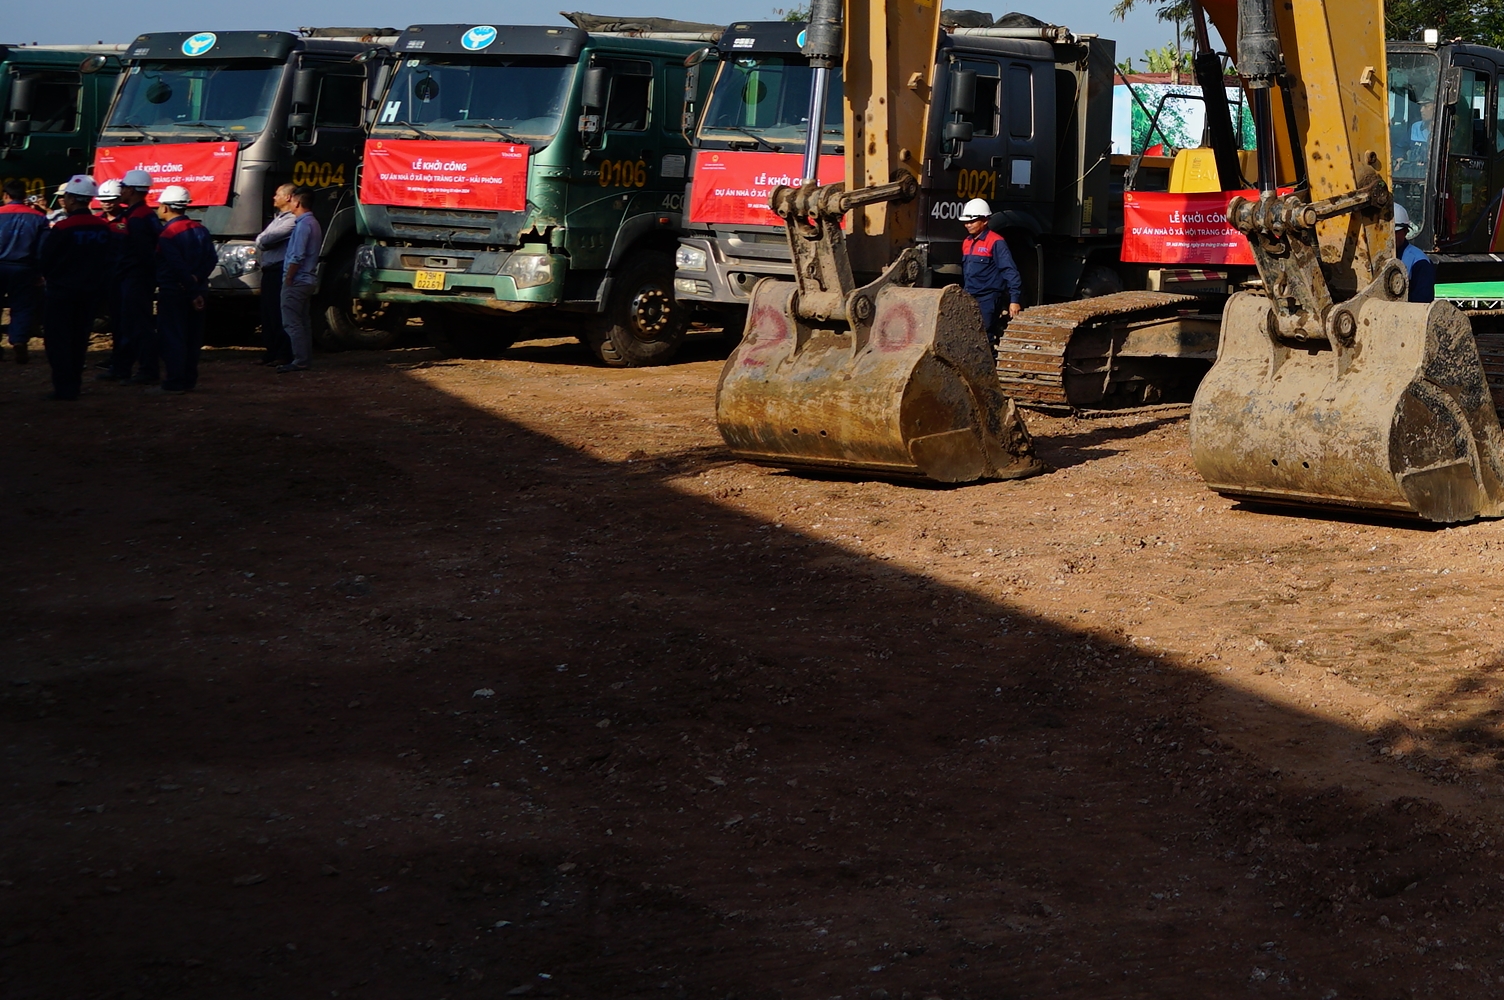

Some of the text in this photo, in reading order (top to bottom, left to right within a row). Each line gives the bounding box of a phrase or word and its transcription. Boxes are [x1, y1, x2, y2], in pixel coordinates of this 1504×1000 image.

[380, 101, 401, 122] H
[293, 161, 345, 188] 0004
[443, 161, 467, 171] CÔNG
[599, 160, 646, 188] 0106
[754, 173, 766, 185] LỄ
[768, 174, 790, 186] KHỞI
[956, 168, 997, 200] 0021
[931, 201, 966, 220] 4C00
[1169, 211, 1227, 223] LỄ KHỞI CÔN
[1169, 227, 1174, 235] Ở
